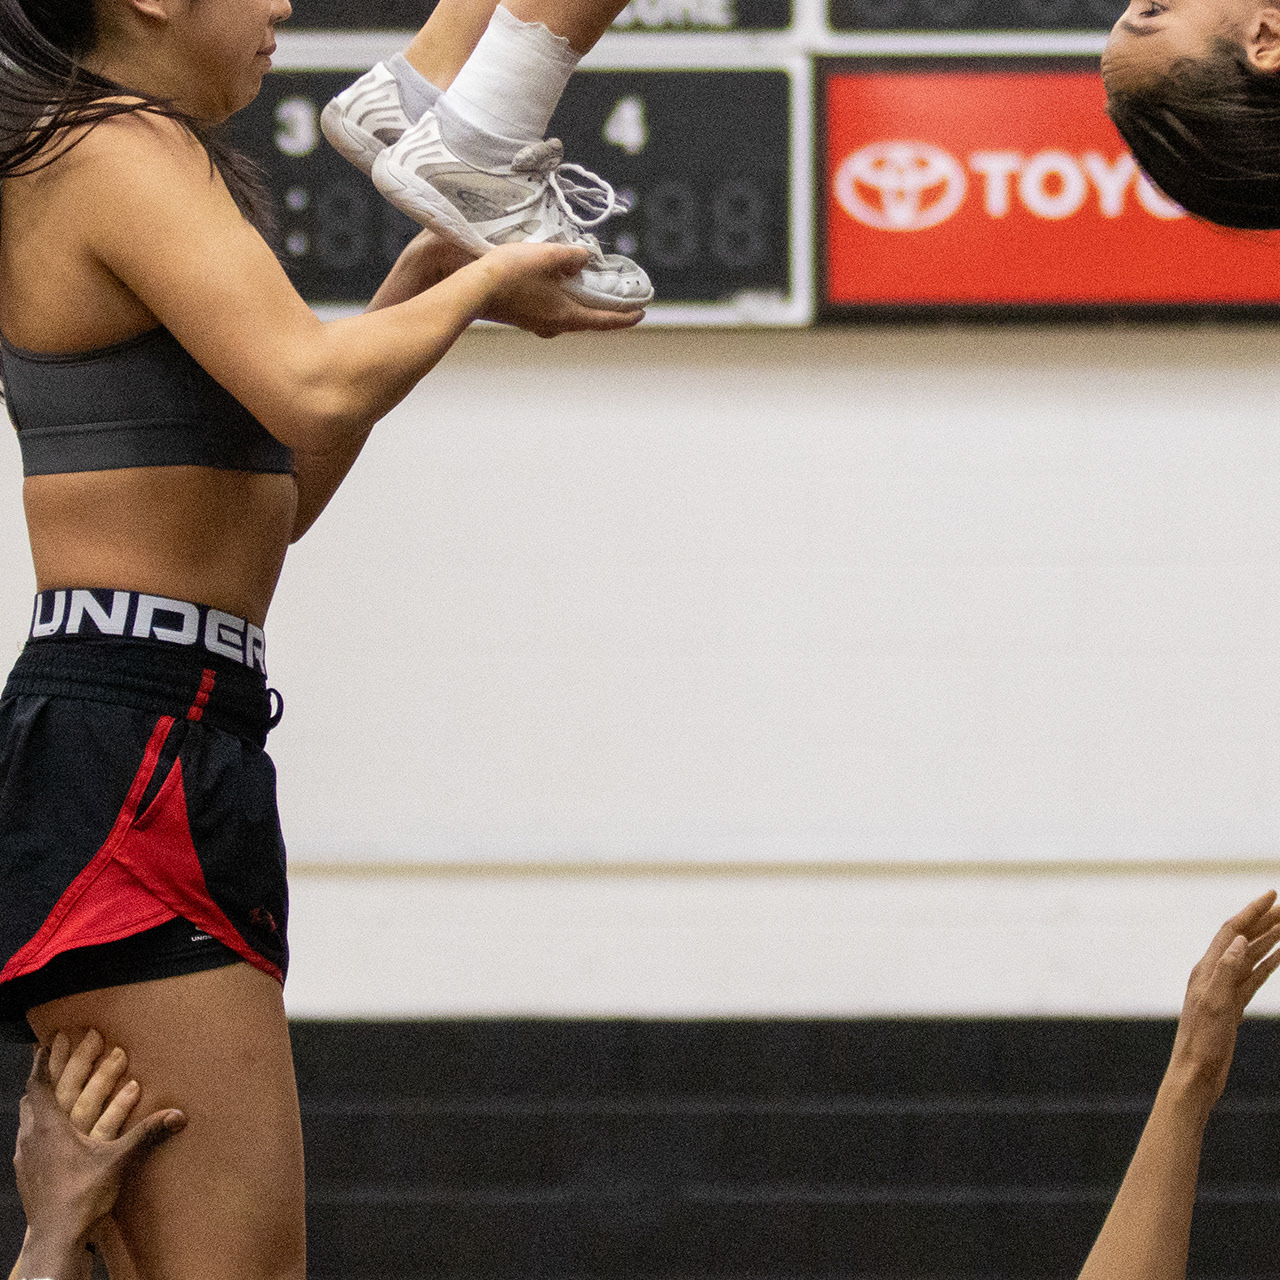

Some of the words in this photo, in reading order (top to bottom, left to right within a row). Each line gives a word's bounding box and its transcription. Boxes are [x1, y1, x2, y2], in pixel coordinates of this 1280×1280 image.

[273, 94, 318, 156] 3
[602, 95, 647, 155] 4
[32, 589, 267, 676] UNDER
